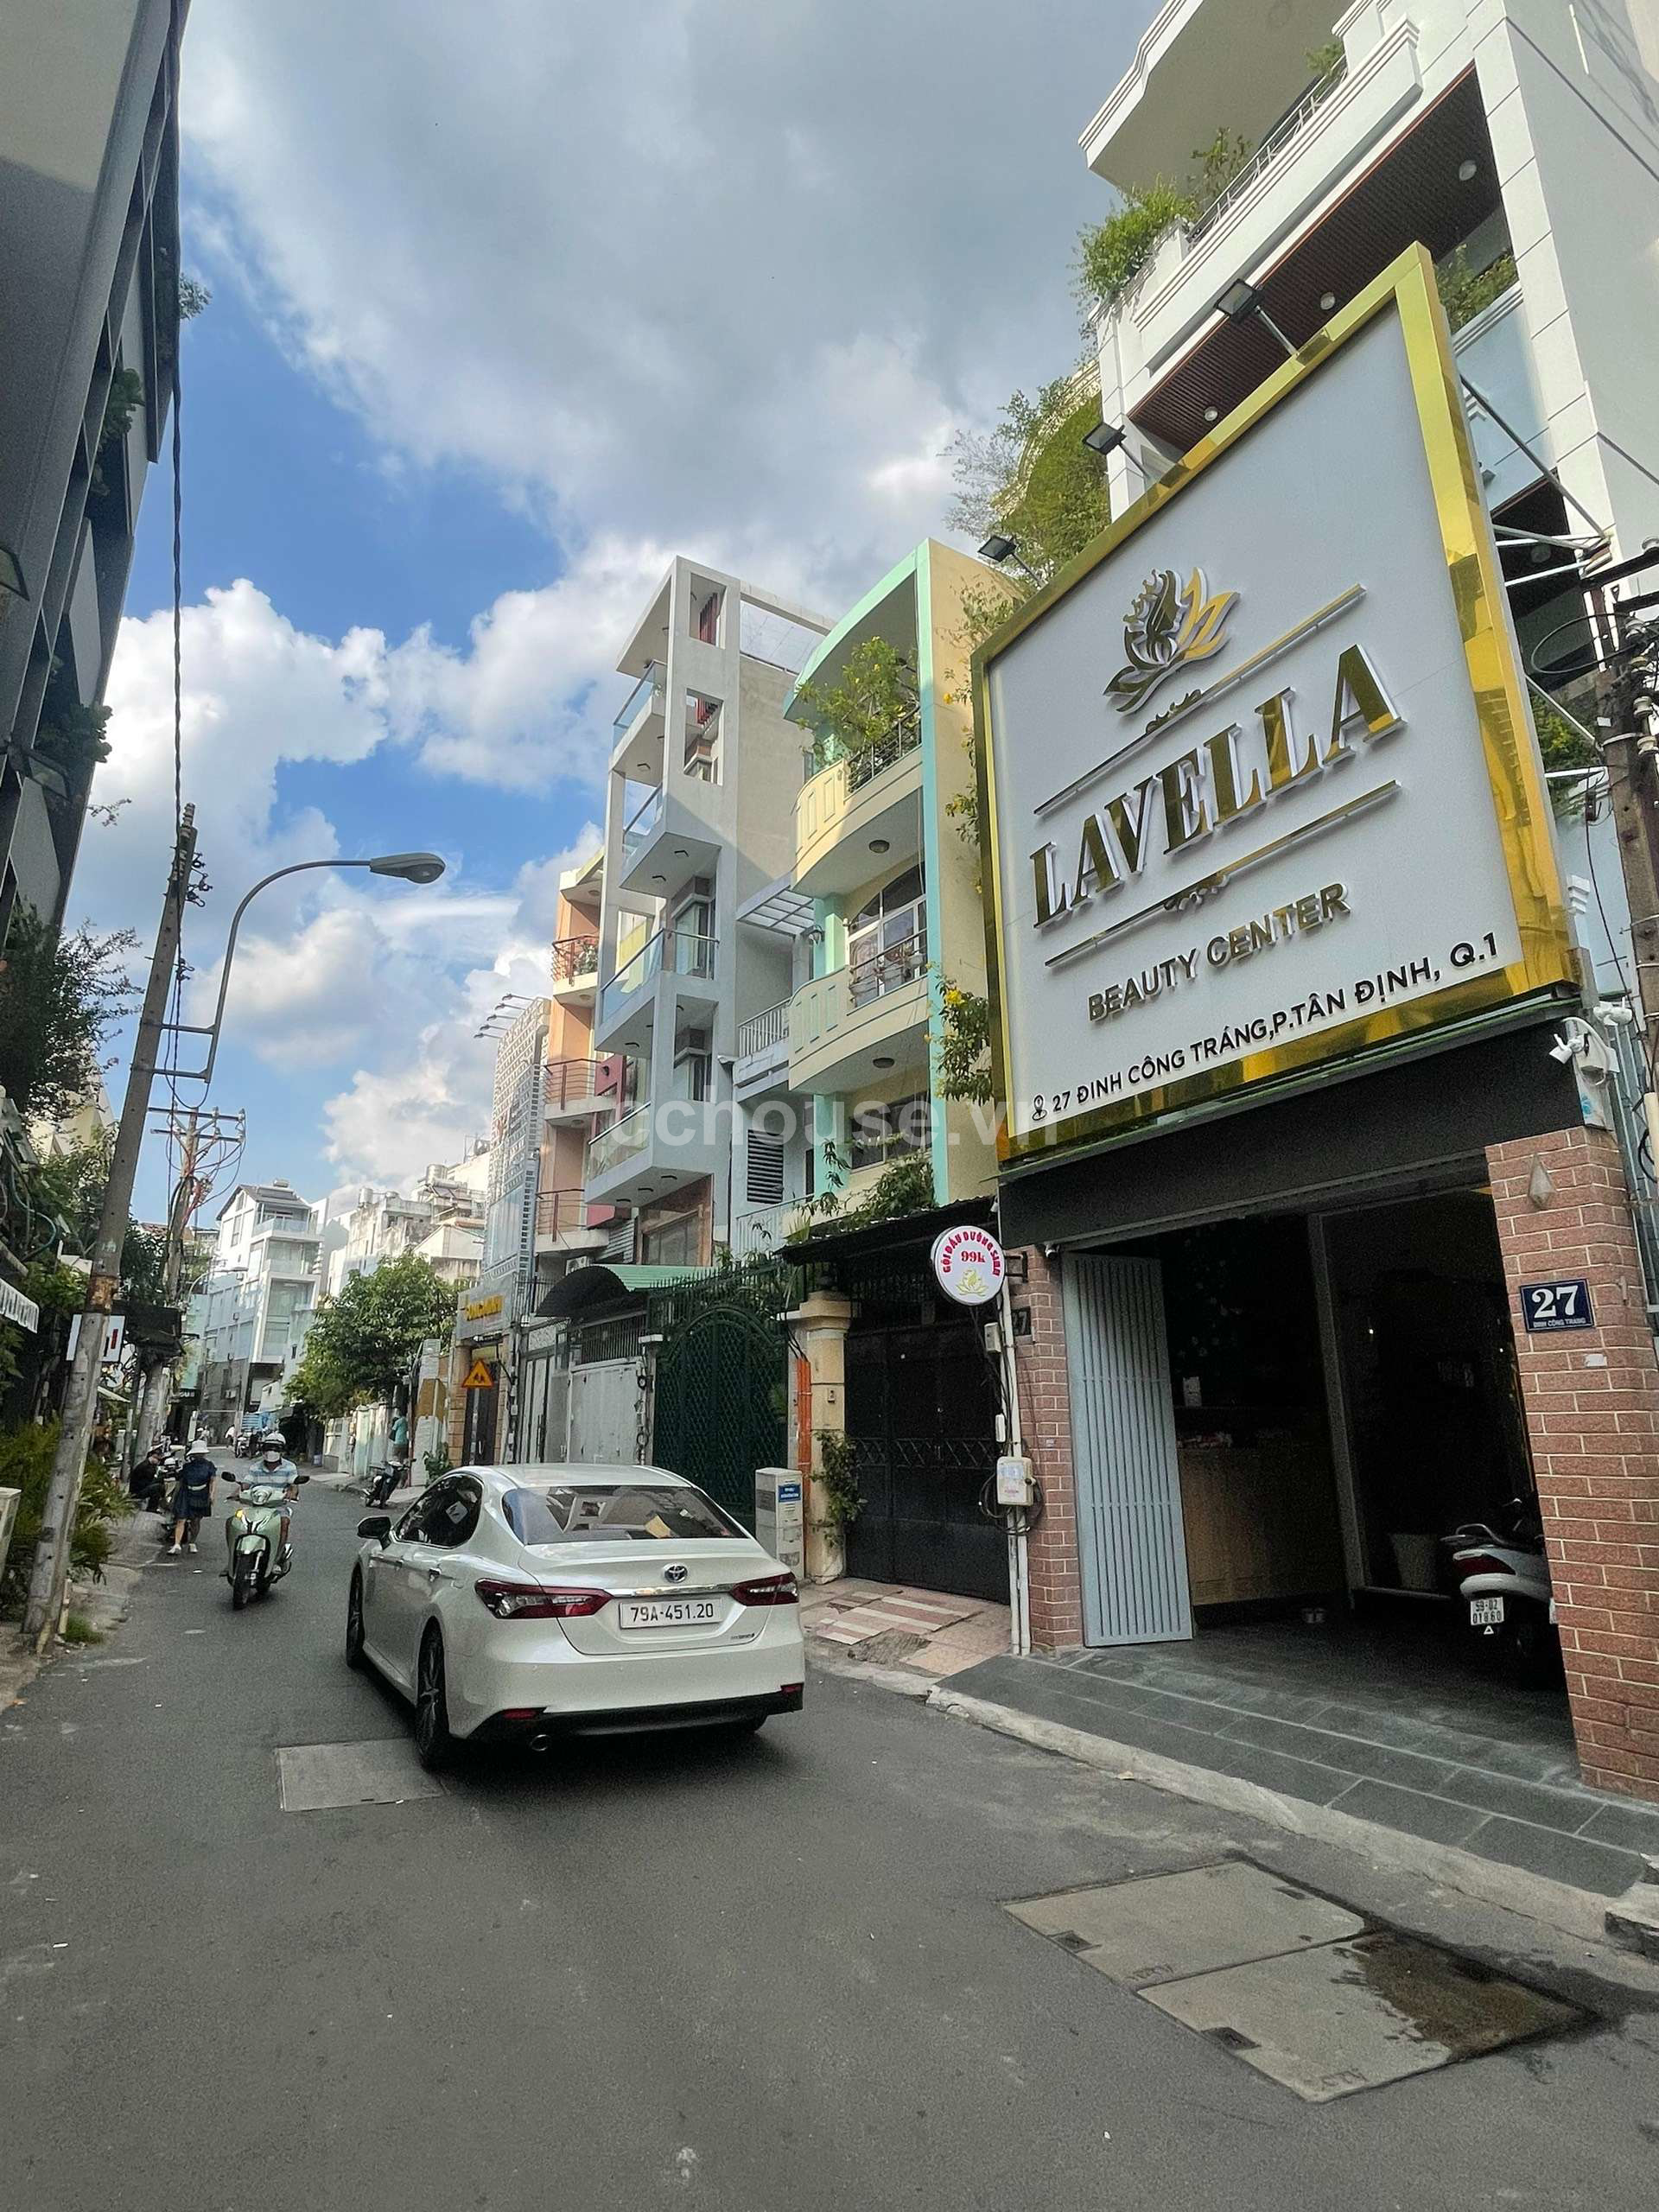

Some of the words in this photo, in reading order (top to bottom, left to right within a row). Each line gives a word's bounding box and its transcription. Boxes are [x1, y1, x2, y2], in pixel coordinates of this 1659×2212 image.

[1030, 643, 1405, 928] LAVELLA
[1052, 1091, 1071, 1112] 27
[1077, 1071, 1123, 1104] ĐINH
[1128, 1048, 1185, 1084] CÔNG
[1355, 957, 1440, 1003] ĐỊNH,
[1450, 931, 1497, 968] Q.1
[1087, 948, 1199, 1023] BEAUTY
[1206, 883, 1351, 968] CENTER
[1531, 1285, 1579, 1319] 27
[630, 1602, 714, 1623] 79A-451.20
